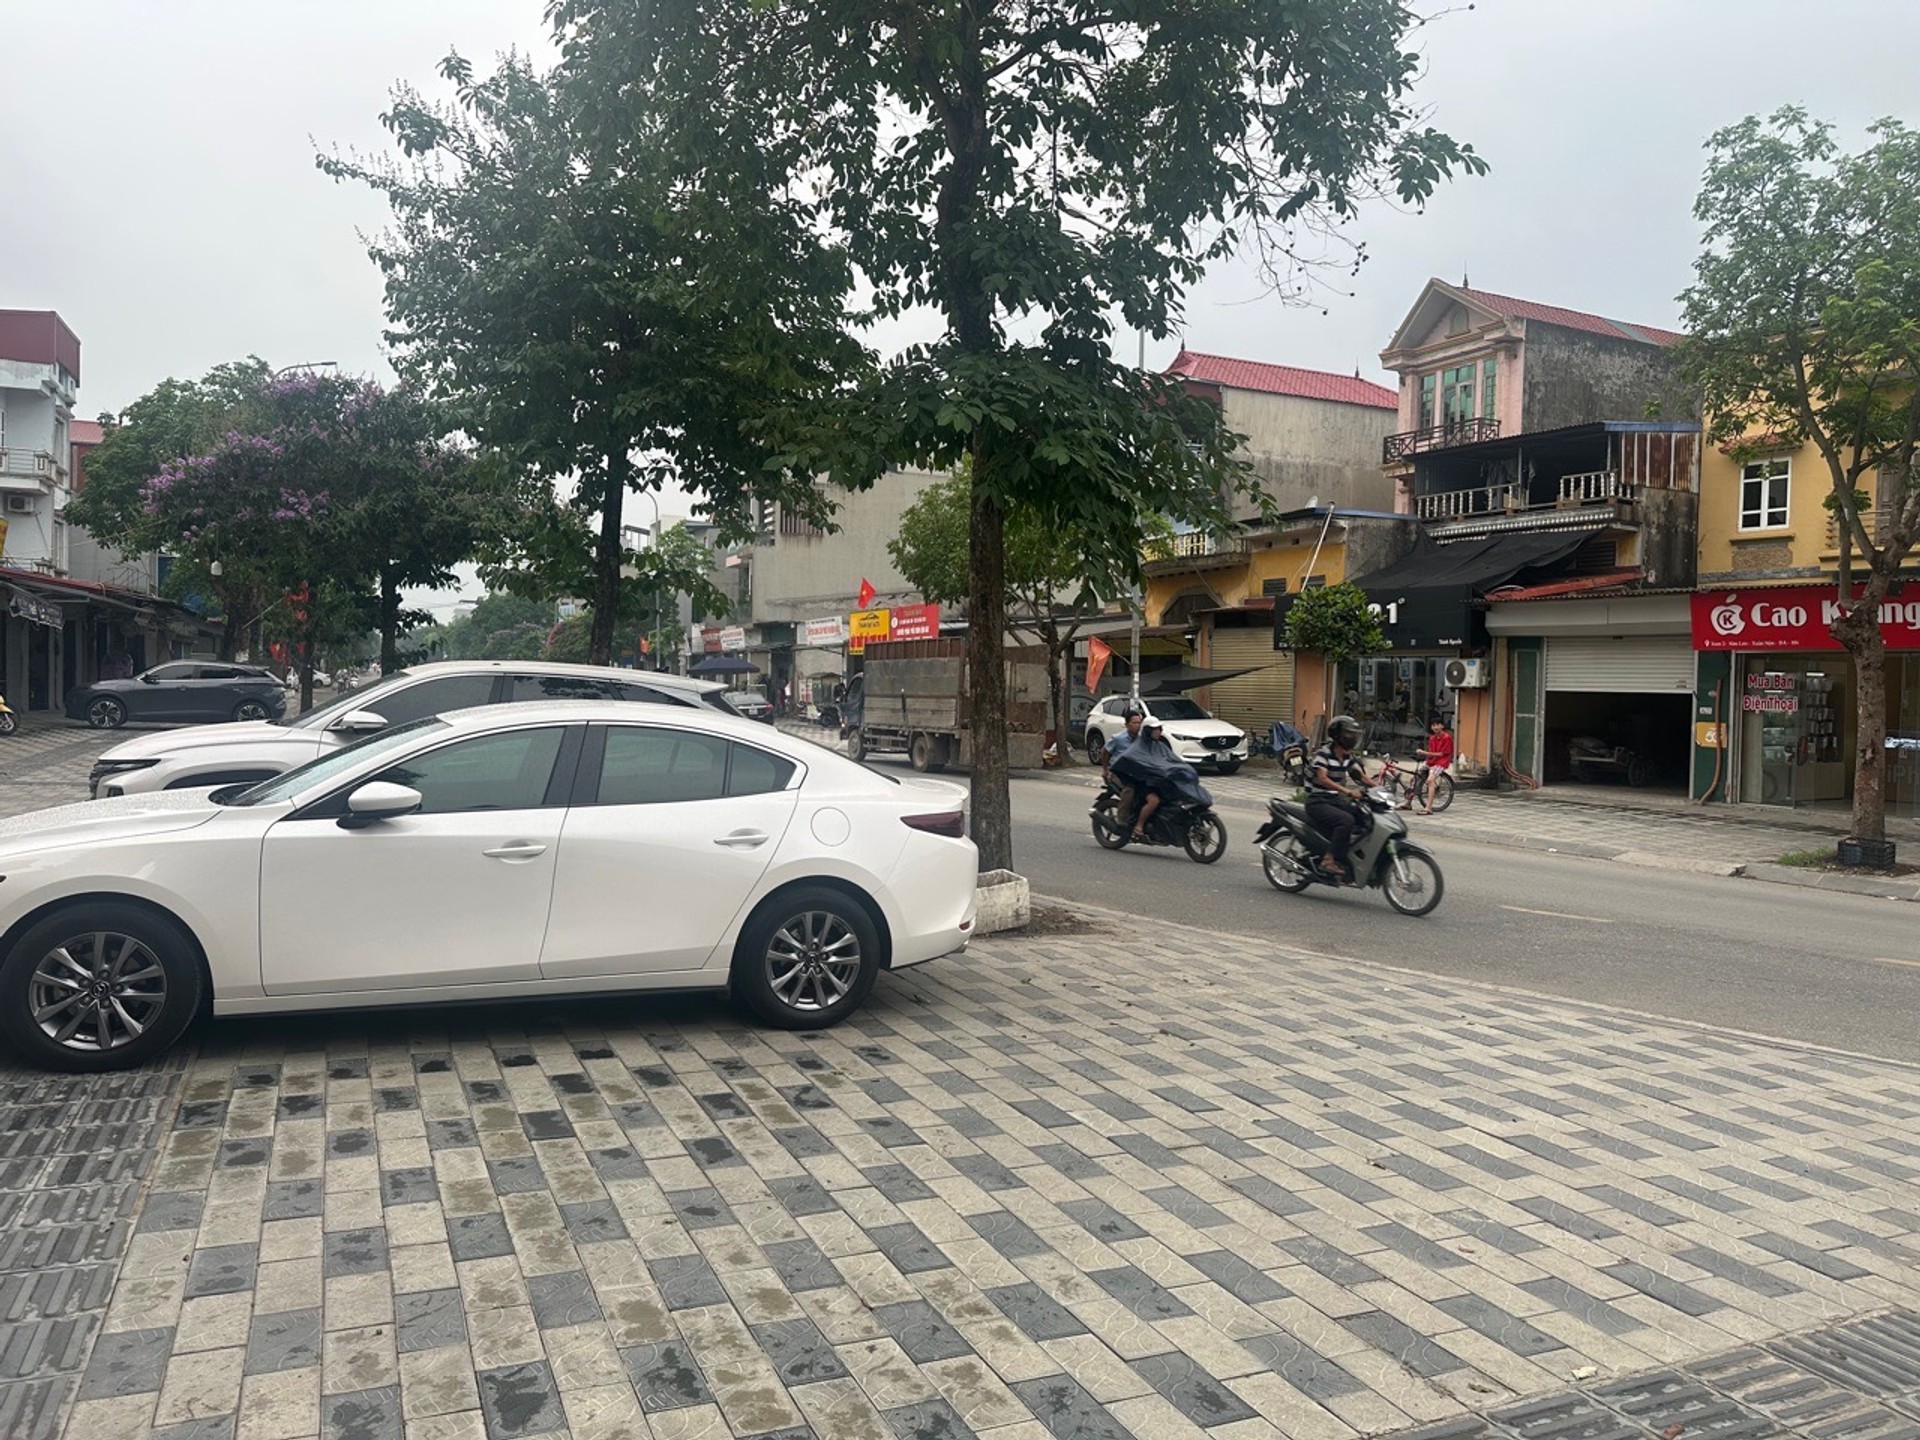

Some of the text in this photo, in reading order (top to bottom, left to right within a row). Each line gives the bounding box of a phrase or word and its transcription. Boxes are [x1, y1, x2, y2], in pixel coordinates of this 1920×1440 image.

[1751, 600, 1920, 630] Cao Kng
[1748, 674, 1770, 688] Mua
